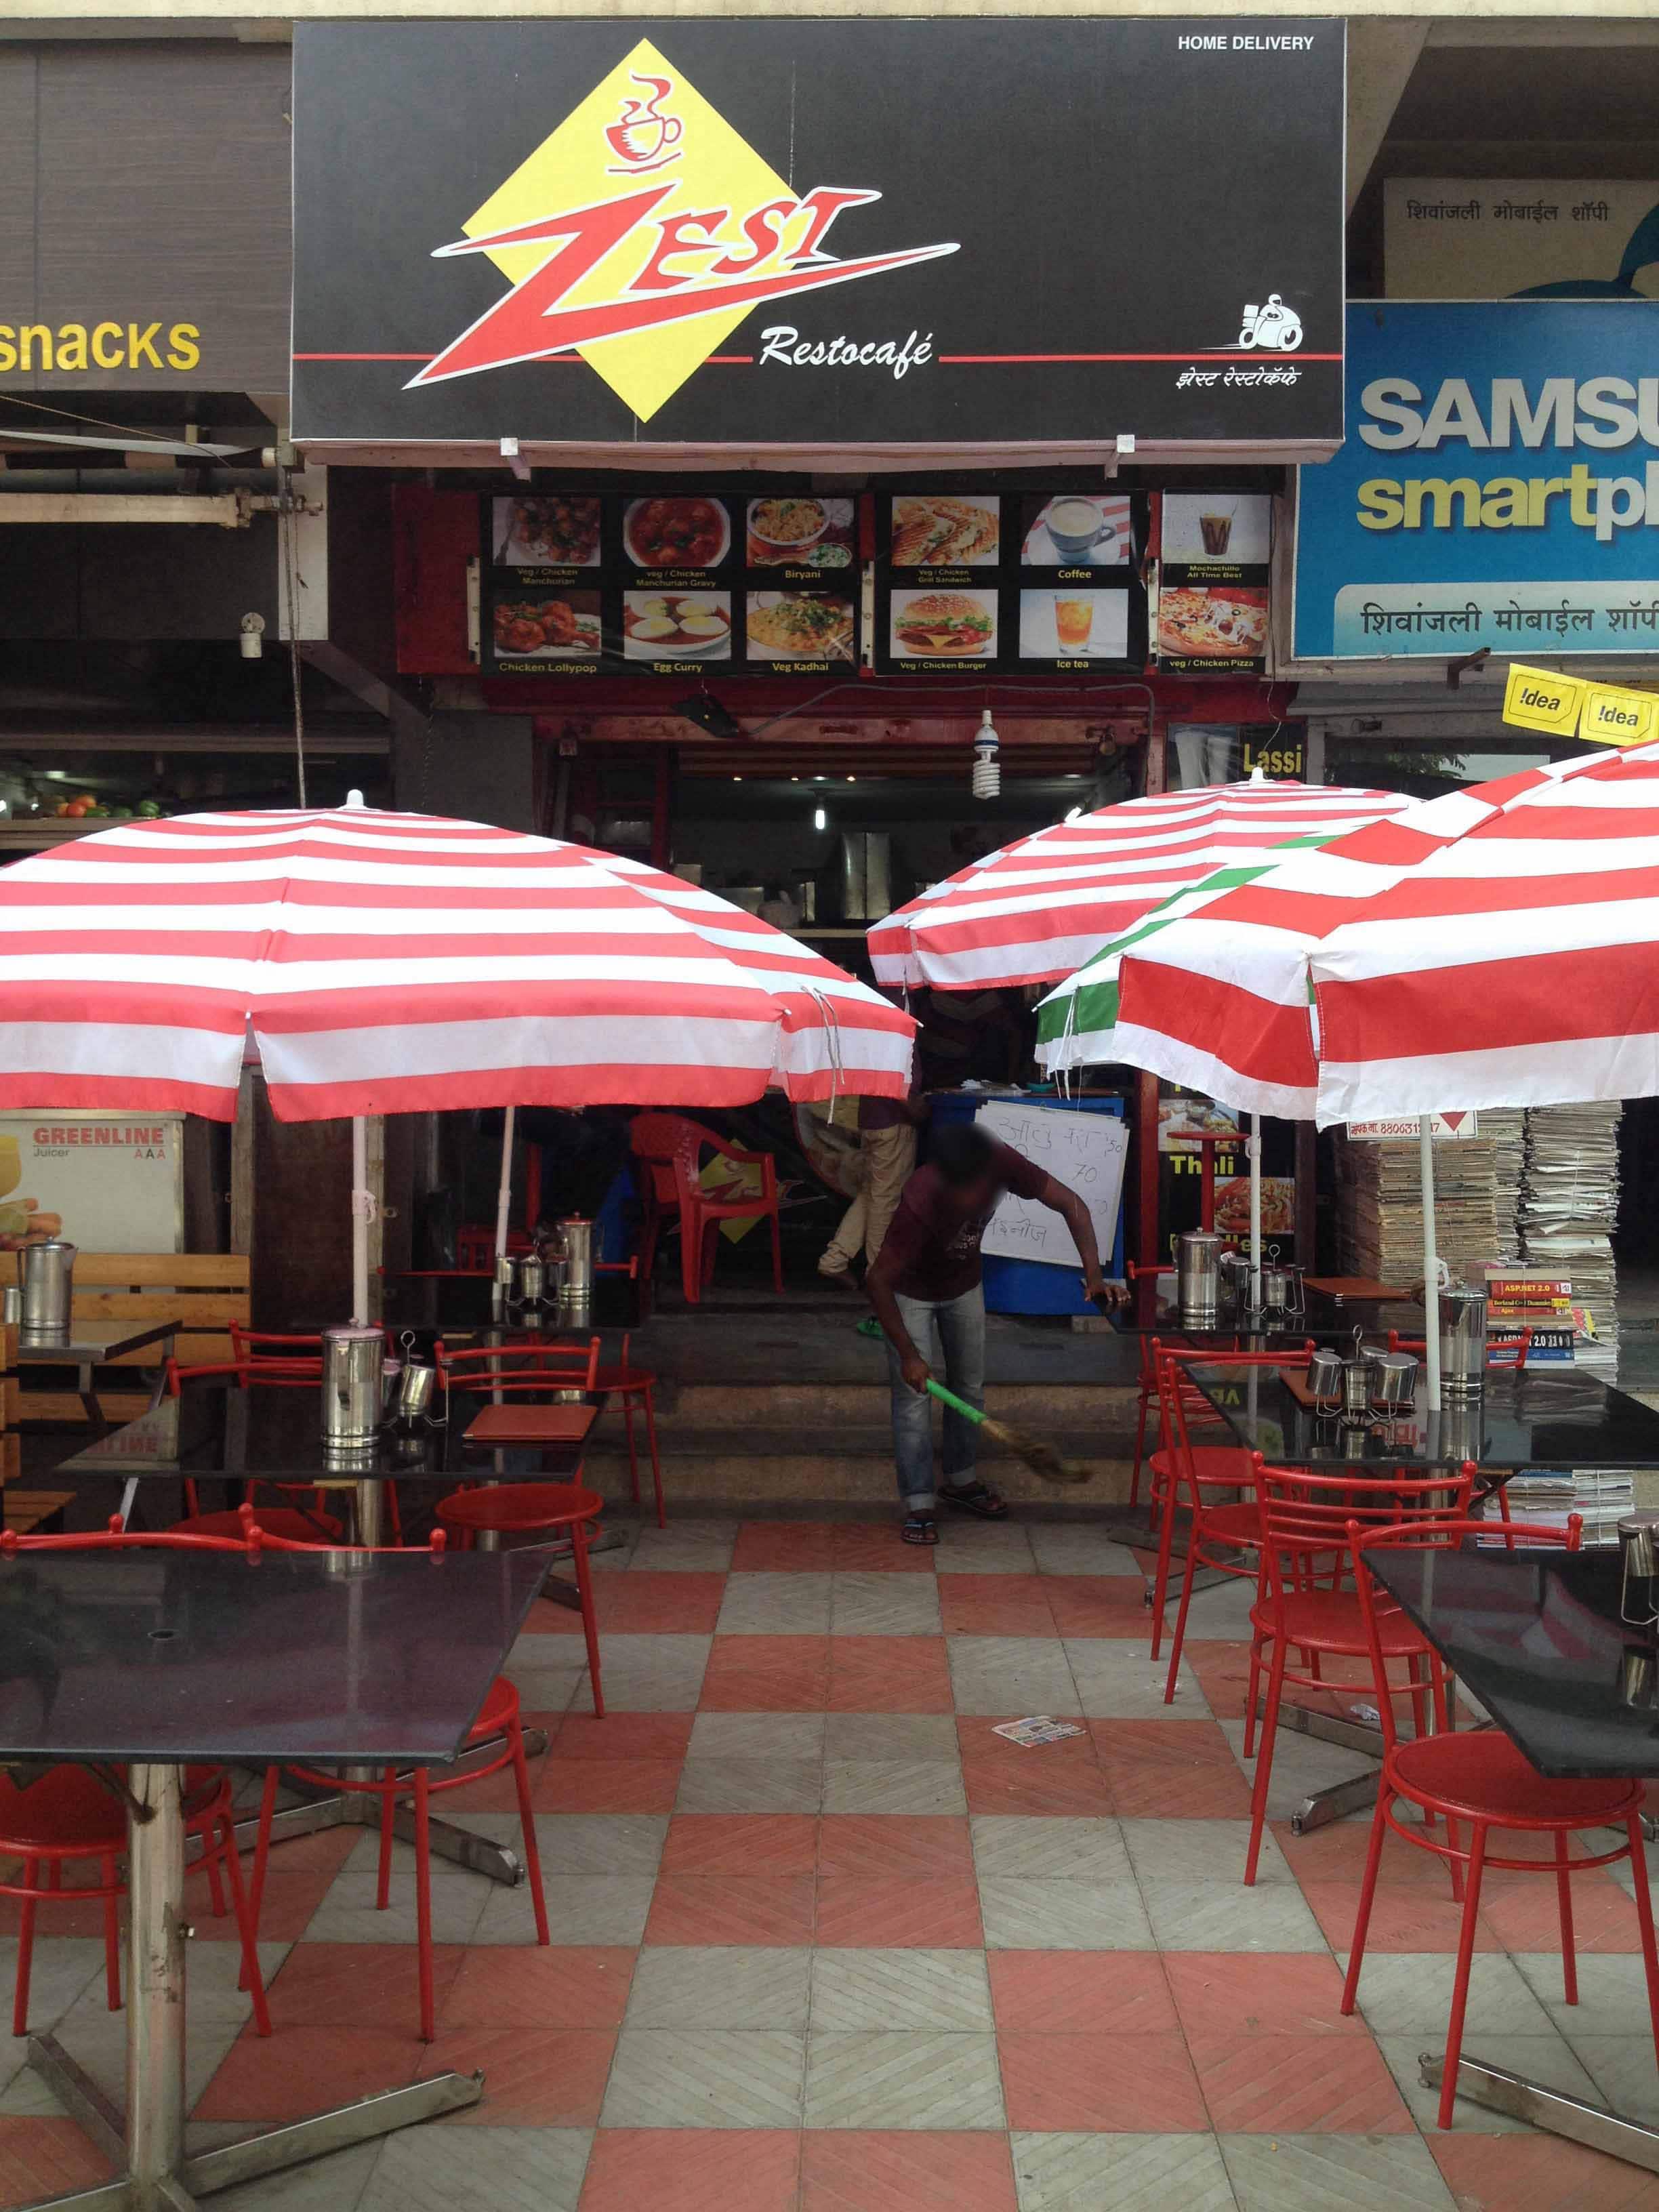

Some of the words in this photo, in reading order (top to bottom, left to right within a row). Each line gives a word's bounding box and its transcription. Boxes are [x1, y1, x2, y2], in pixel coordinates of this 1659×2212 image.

[1178, 36, 1227, 49] HOME
[1233, 36, 1314, 50] DELIVERY
[758, 325, 933, 381] Restocafé
[1176, 367, 1221, 389] झेस्ट
[785, 570, 821, 579] Biryani
[1058, 569, 1092, 579] Coffee
[690, 579, 716, 588] Gravy
[1359, 602, 1482, 635] शिवांजली
[1493, 599, 1595, 637] मोबाईल
[499, 663, 545, 672] Chicken
[548, 663, 597, 674] Lollypop
[653, 663, 672, 673] Egg
[674, 663, 703, 673] Curry
[772, 663, 791, 673] Veg
[794, 663, 829, 671] Kadhai
[958, 661, 987, 670] Burger
[1057, 660, 1071, 668] Ice
[1073, 660, 1089, 668] tea
[1243, 743, 1302, 774] Lassi
[33, 1127, 165, 1145] GREENLINE
[34, 1148, 70, 1158] Juicer
[1169, 1155, 1235, 1174] Thli
[1537, 1284, 1551, 1292] 2.0
